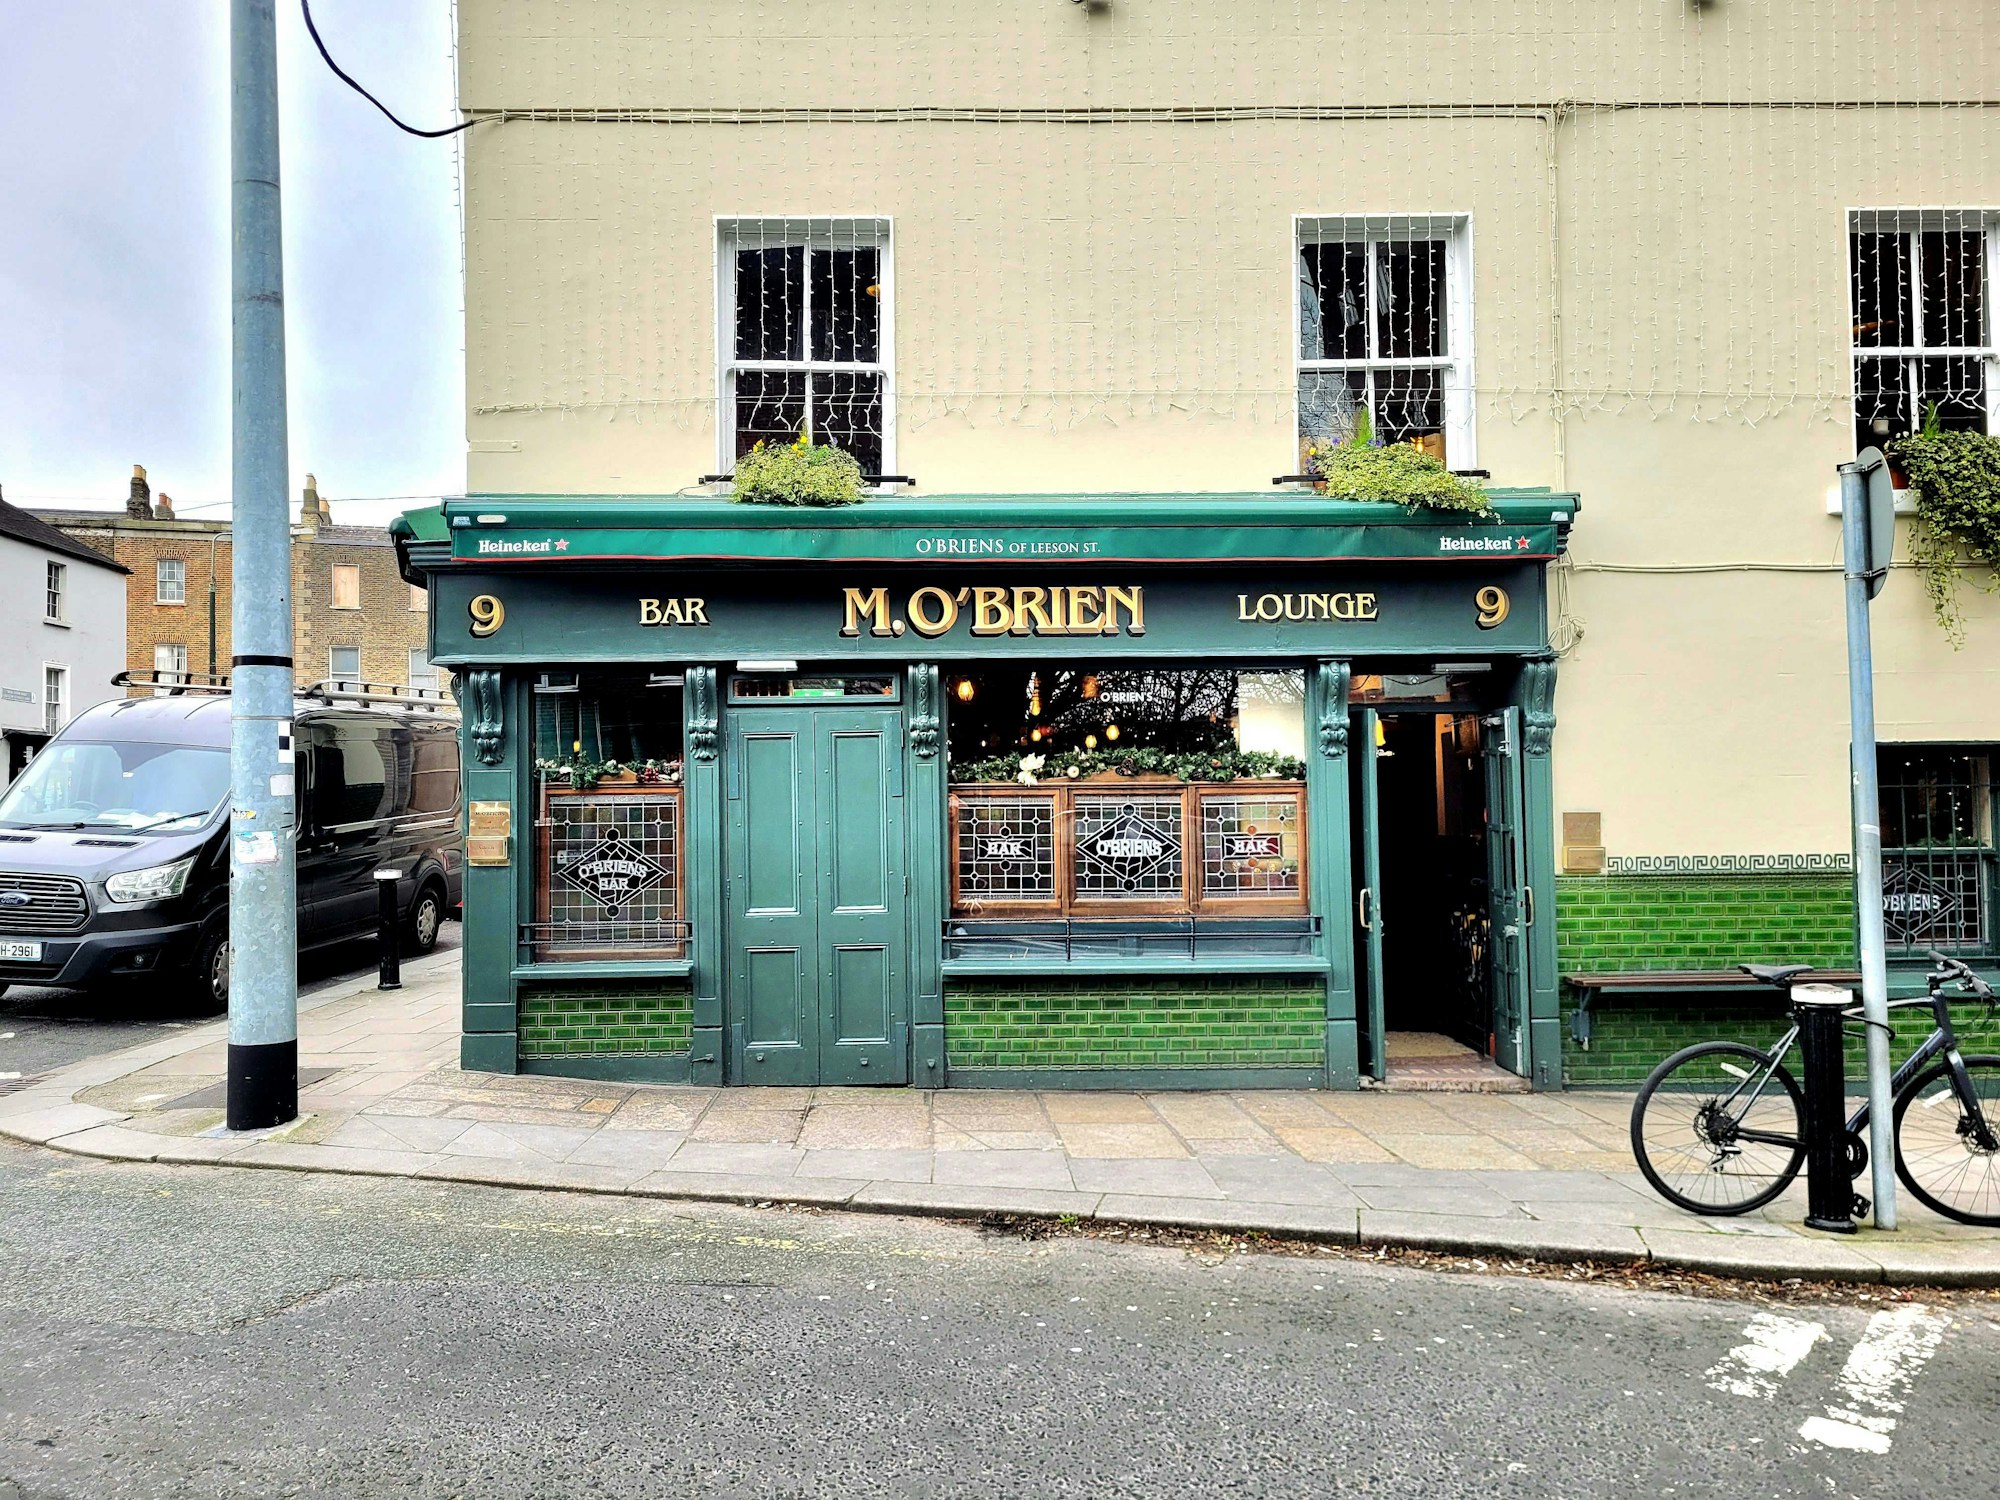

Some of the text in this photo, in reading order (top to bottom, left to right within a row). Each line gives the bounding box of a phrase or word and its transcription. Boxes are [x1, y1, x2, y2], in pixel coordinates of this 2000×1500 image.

[478, 539, 551, 553] Heineken
[916, 539, 1100, 554] O'BRIENS OF LEESON ST.
[1440, 536, 1512, 551] Heineken
[639, 598, 711, 626] BAR
[1237, 593, 1378, 621] LOUNGE
[1475, 585, 1510, 627] 9
[469, 594, 505, 635] 9
[987, 842, 1022, 855] BAR
[1096, 839, 1162, 857] O'BRIENS
[1234, 839, 1269, 853] BAR
[579, 860, 648, 878] O'BRIENS
[599, 878, 630, 890] BAR
